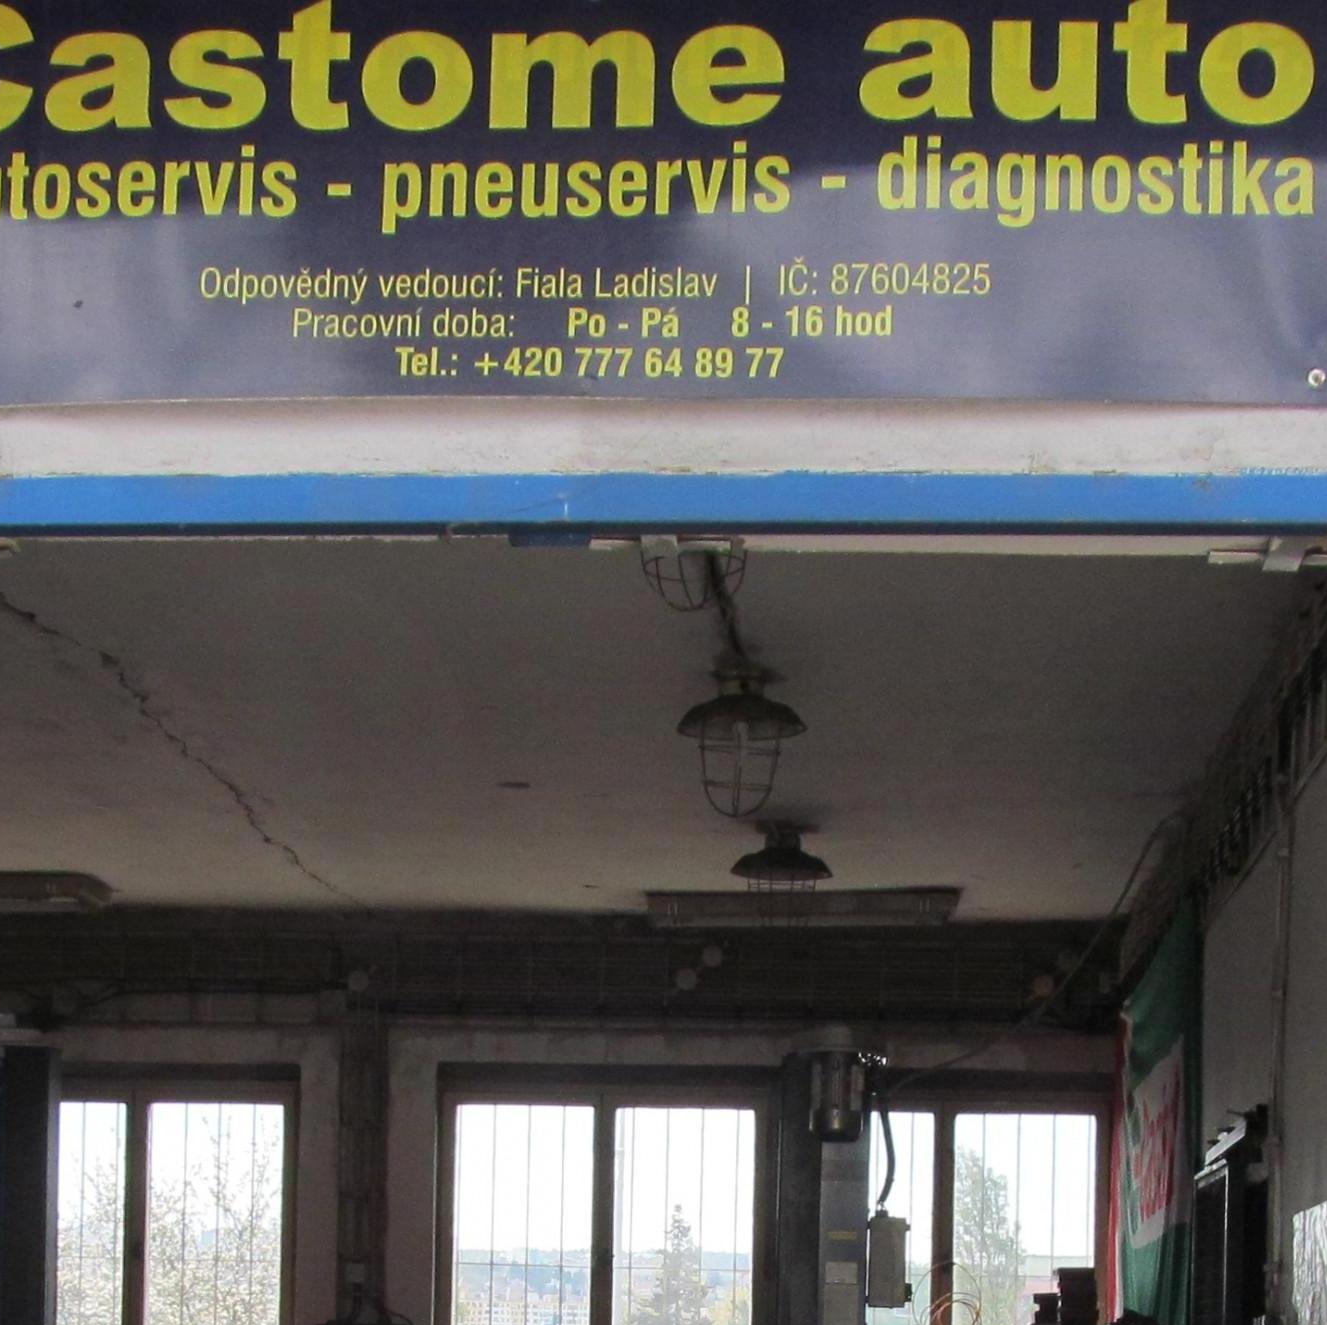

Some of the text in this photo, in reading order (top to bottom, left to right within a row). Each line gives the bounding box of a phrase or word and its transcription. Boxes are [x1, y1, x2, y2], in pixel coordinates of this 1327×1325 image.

[859, 0, 1315, 126] auto
[327, 183, 352, 197] -
[381, 141, 791, 235] pneuservis
[821, 175, 846, 190] -
[877, 135, 1315, 228] diagnostika
[199, 266, 368, 304] Odpovědný
[379, 267, 504, 299] vedoucí:
[516, 267, 583, 298] Fiala
[595, 266, 718, 298] Ladislav
[779, 256, 818, 296] IČ:
[830, 263, 992, 295] 87604825
[292, 308, 422, 338] Pracovní
[432, 307, 515, 338] doba:
[567, 308, 606, 338] Po
[640, 306, 681, 339] Pá
[730, 306, 751, 338] 8
[784, 305, 824, 337] 16
[834, 304, 893, 337] hod
[394, 346, 786, 378] Tel.: +420 777 64 89 77
